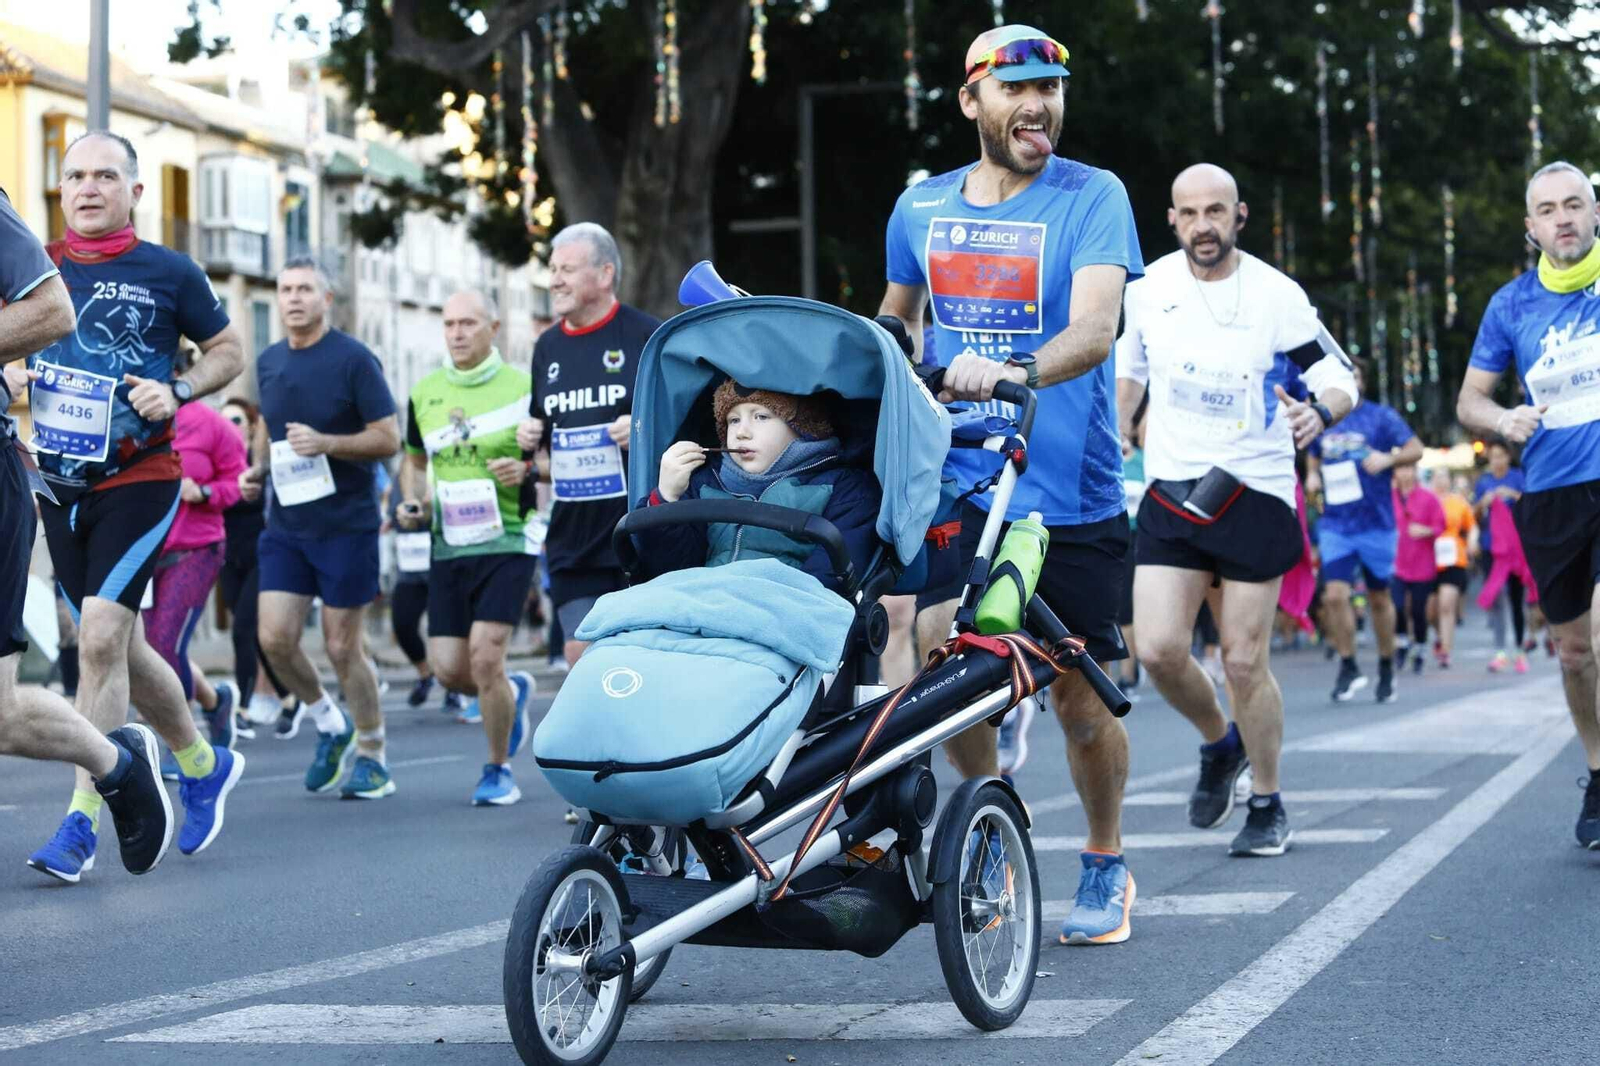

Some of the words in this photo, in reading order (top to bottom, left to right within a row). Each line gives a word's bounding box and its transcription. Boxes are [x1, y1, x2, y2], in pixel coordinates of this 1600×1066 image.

[970, 231, 1019, 244] ZURICH
[92, 281, 117, 299] 25
[56, 375, 94, 391] ZURICH
[544, 384, 627, 417] PHILIP
[1200, 391, 1234, 406] 8622
[57, 403, 93, 420] 4436
[576, 454, 606, 468] 3552
